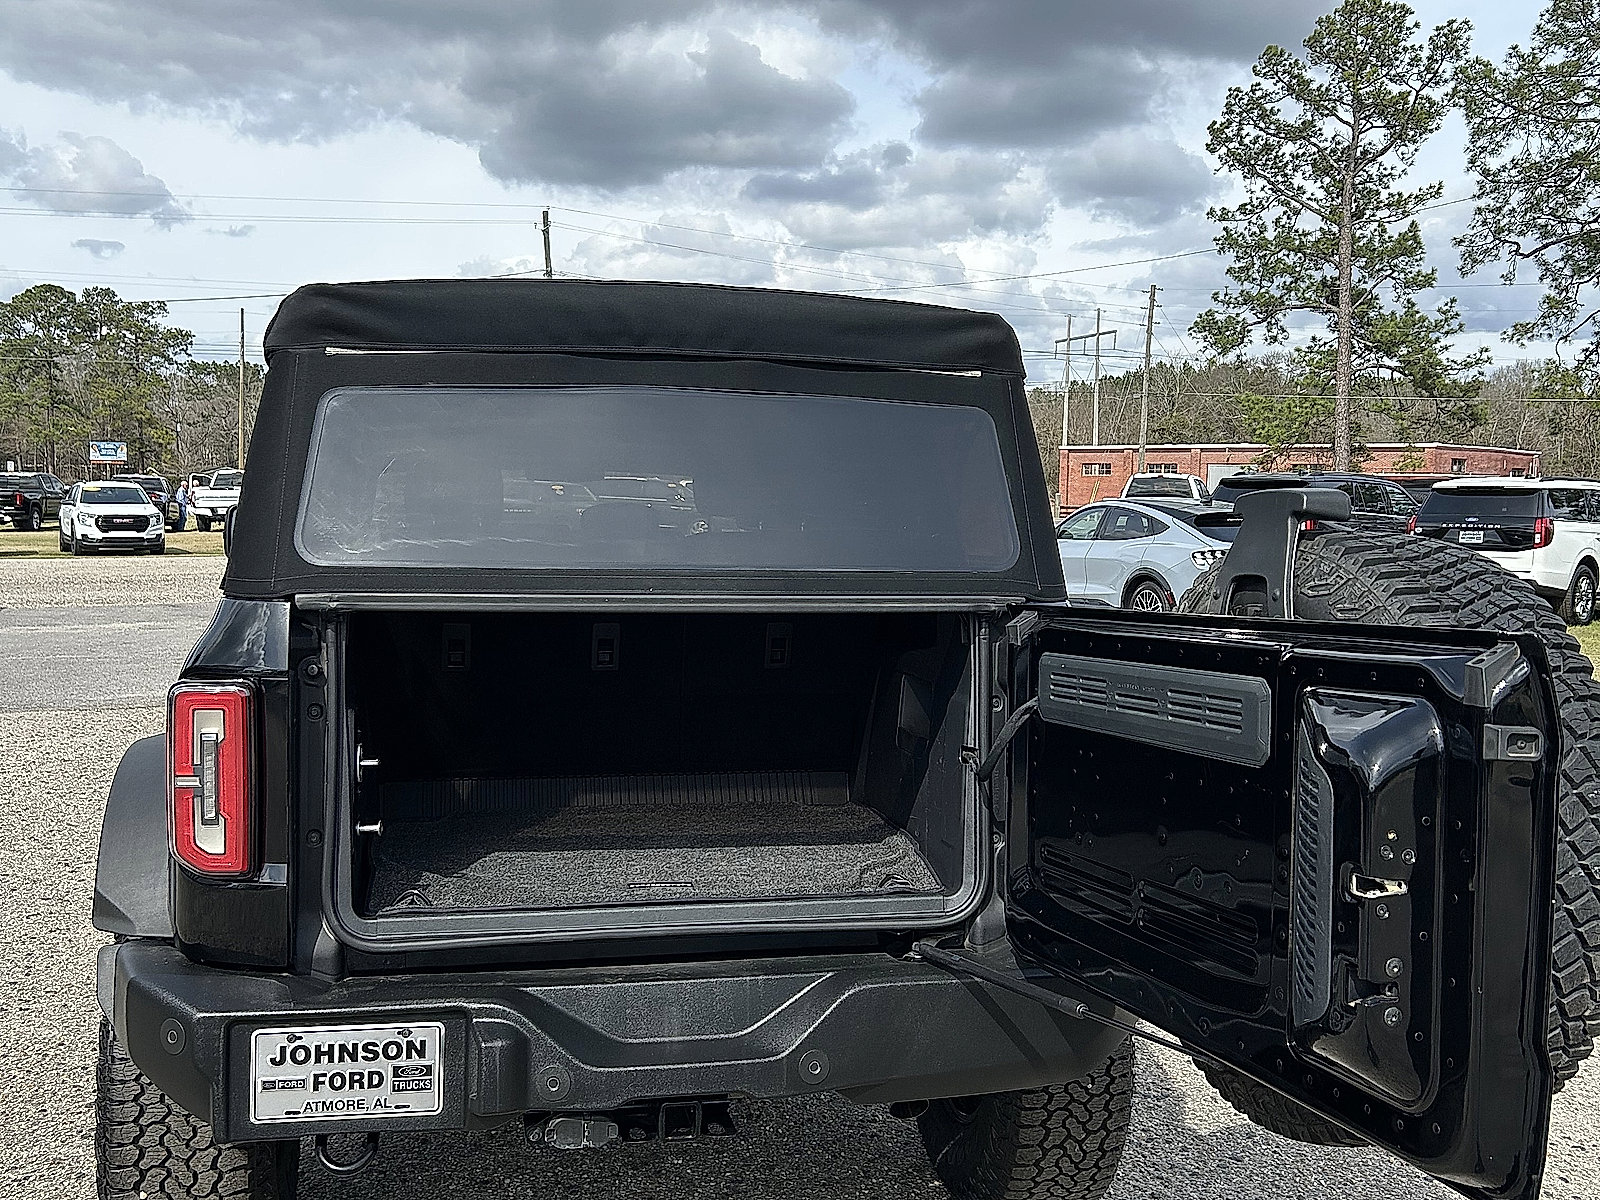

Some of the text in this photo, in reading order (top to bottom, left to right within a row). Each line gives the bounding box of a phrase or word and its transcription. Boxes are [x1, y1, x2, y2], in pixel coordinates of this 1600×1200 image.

[269, 1039, 427, 1066] JOHNSON
[278, 1080, 304, 1089] FORD
[312, 1070, 385, 1092] FORD
[393, 1079, 431, 1090] TRUCKS
[303, 1097, 392, 1113] ATMORE, AL
